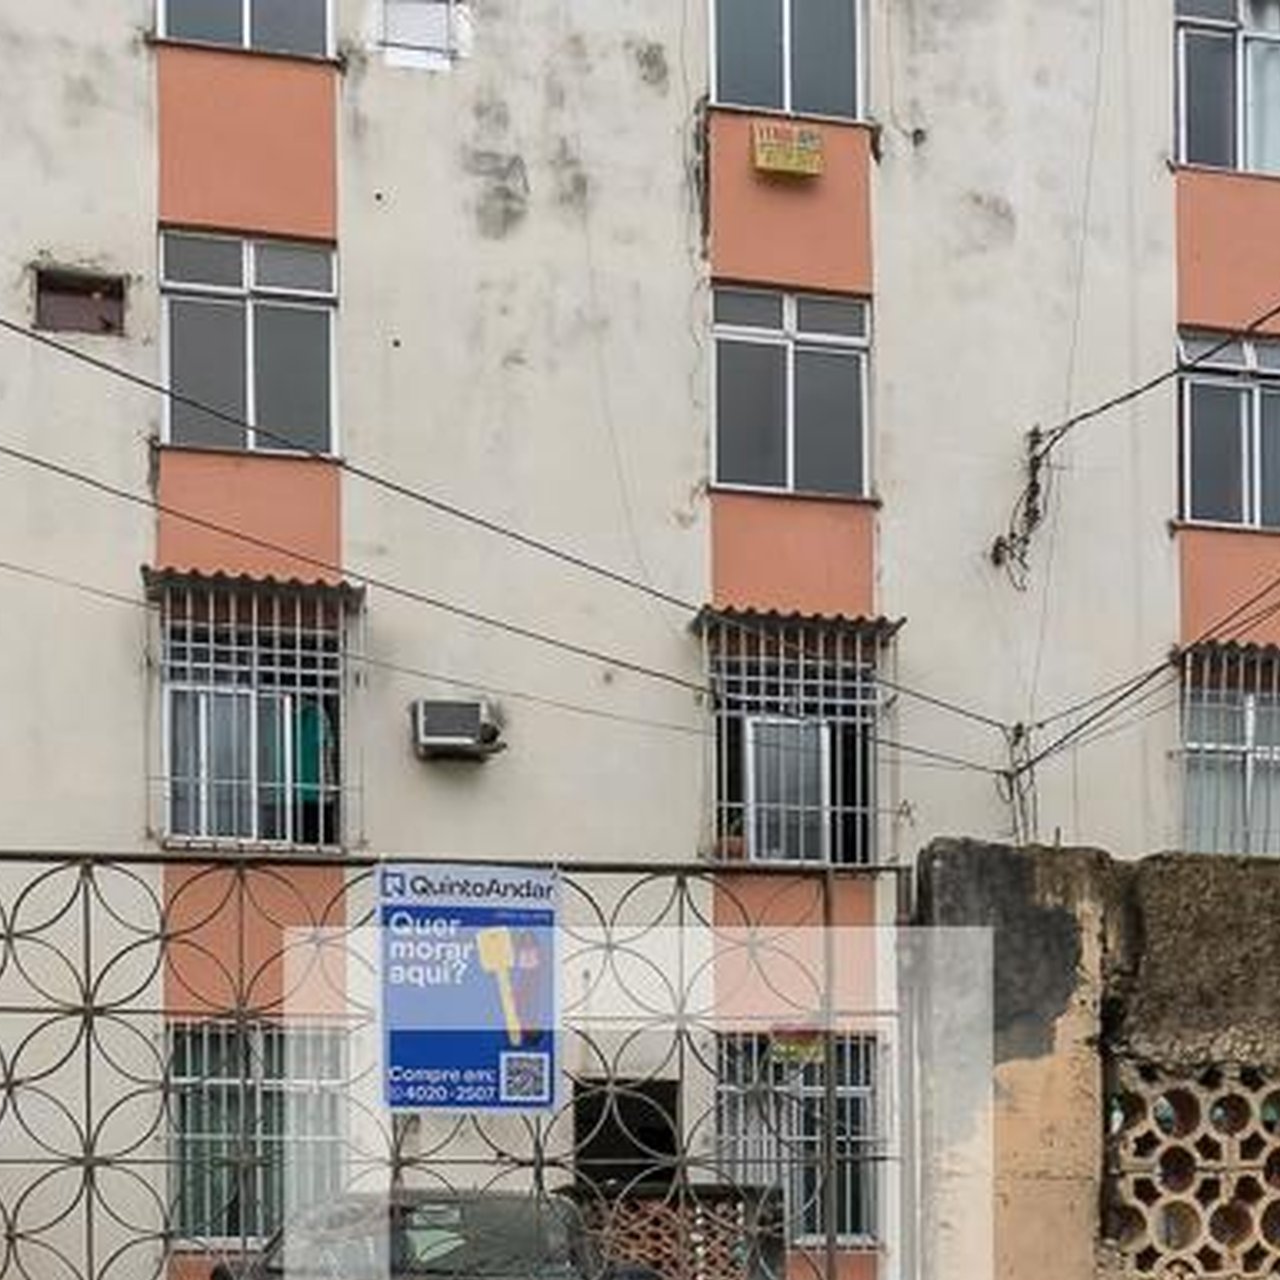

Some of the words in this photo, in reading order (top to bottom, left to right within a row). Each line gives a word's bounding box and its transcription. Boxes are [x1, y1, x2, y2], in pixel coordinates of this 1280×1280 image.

[410, 876, 554, 899] QuintoAndar
[389, 911, 462, 937] Quer
[389, 939, 475, 962] morar
[388, 957, 469, 987] aqui?
[389, 1065, 461, 1085] Compre
